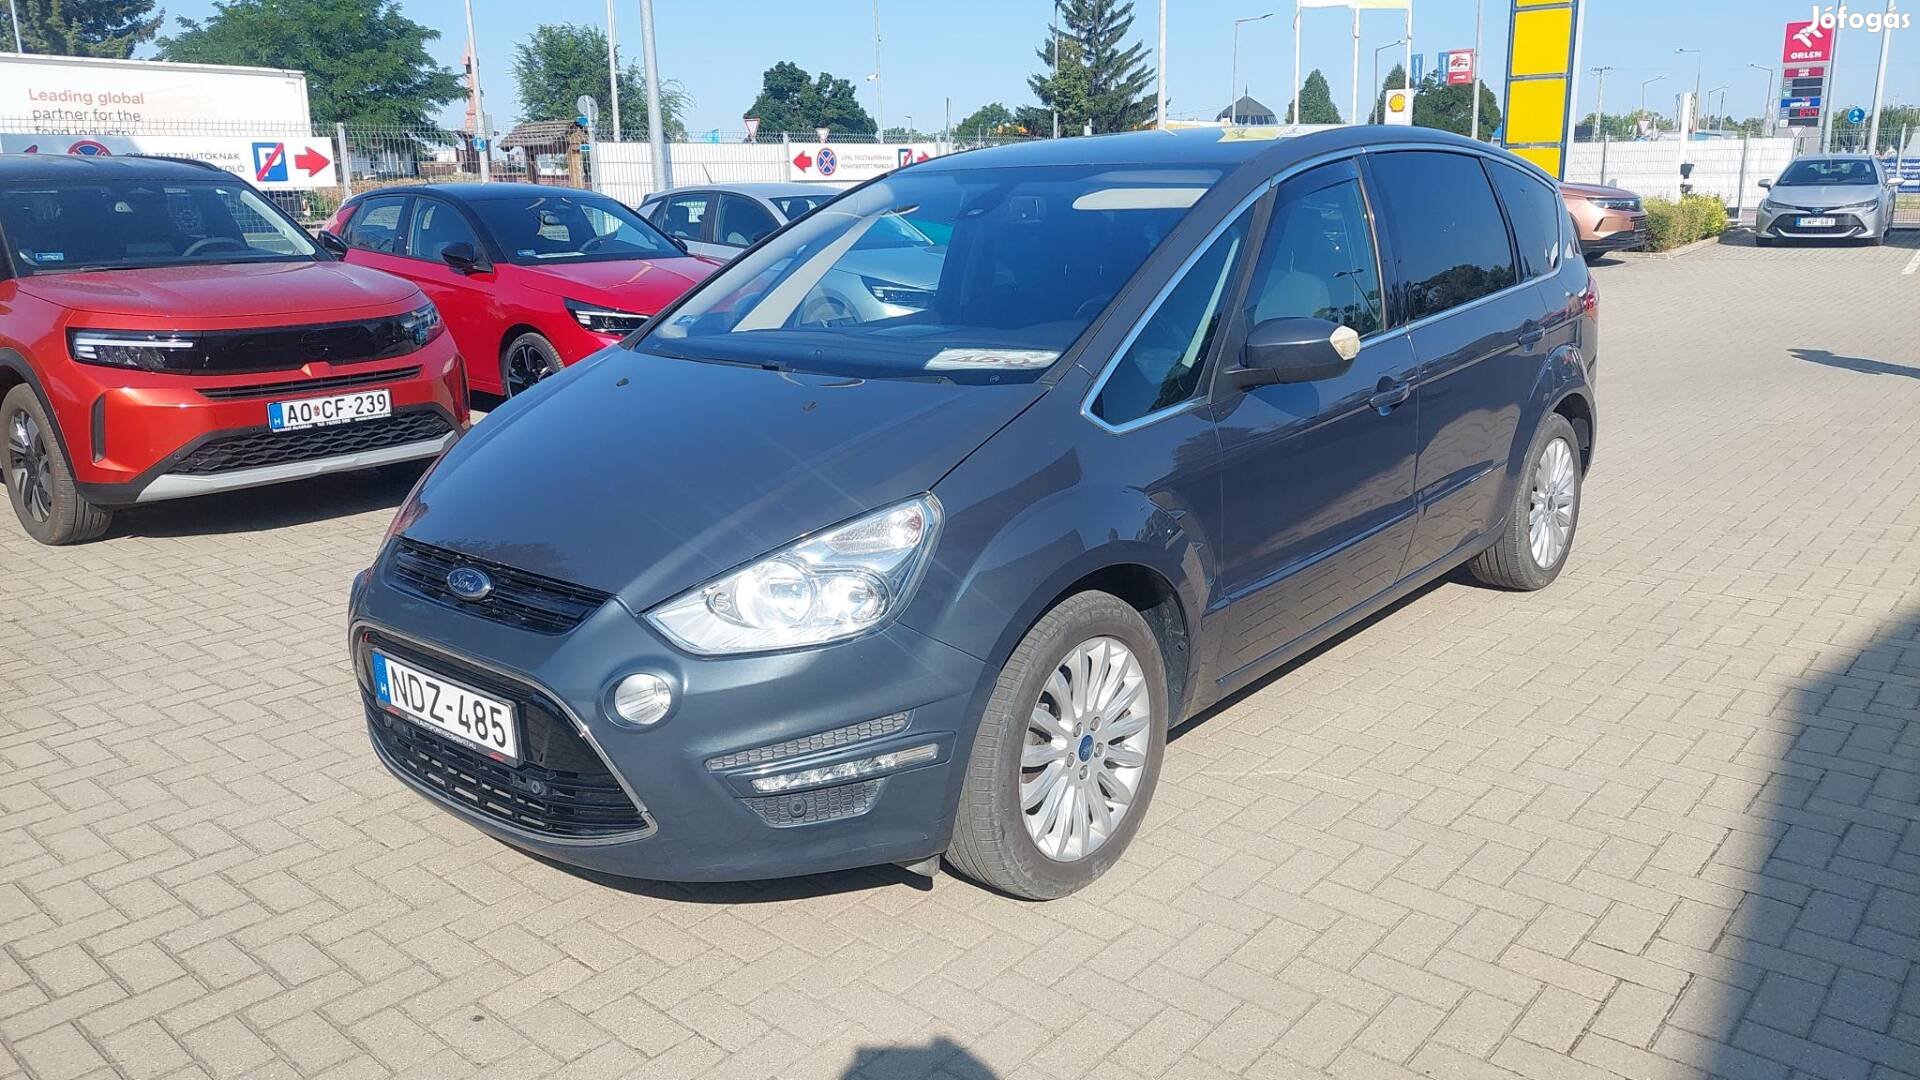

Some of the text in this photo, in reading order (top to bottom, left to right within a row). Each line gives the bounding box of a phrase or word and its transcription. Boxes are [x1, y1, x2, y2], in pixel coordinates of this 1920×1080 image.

[1790, 51, 1822, 60] ORLEN
[28, 88, 144, 106] Leading global
[32, 108, 141, 121] partner for the
[287, 402, 312, 424] AO
[321, 393, 387, 419] CF-239
[390, 665, 506, 749] NDZ-485
